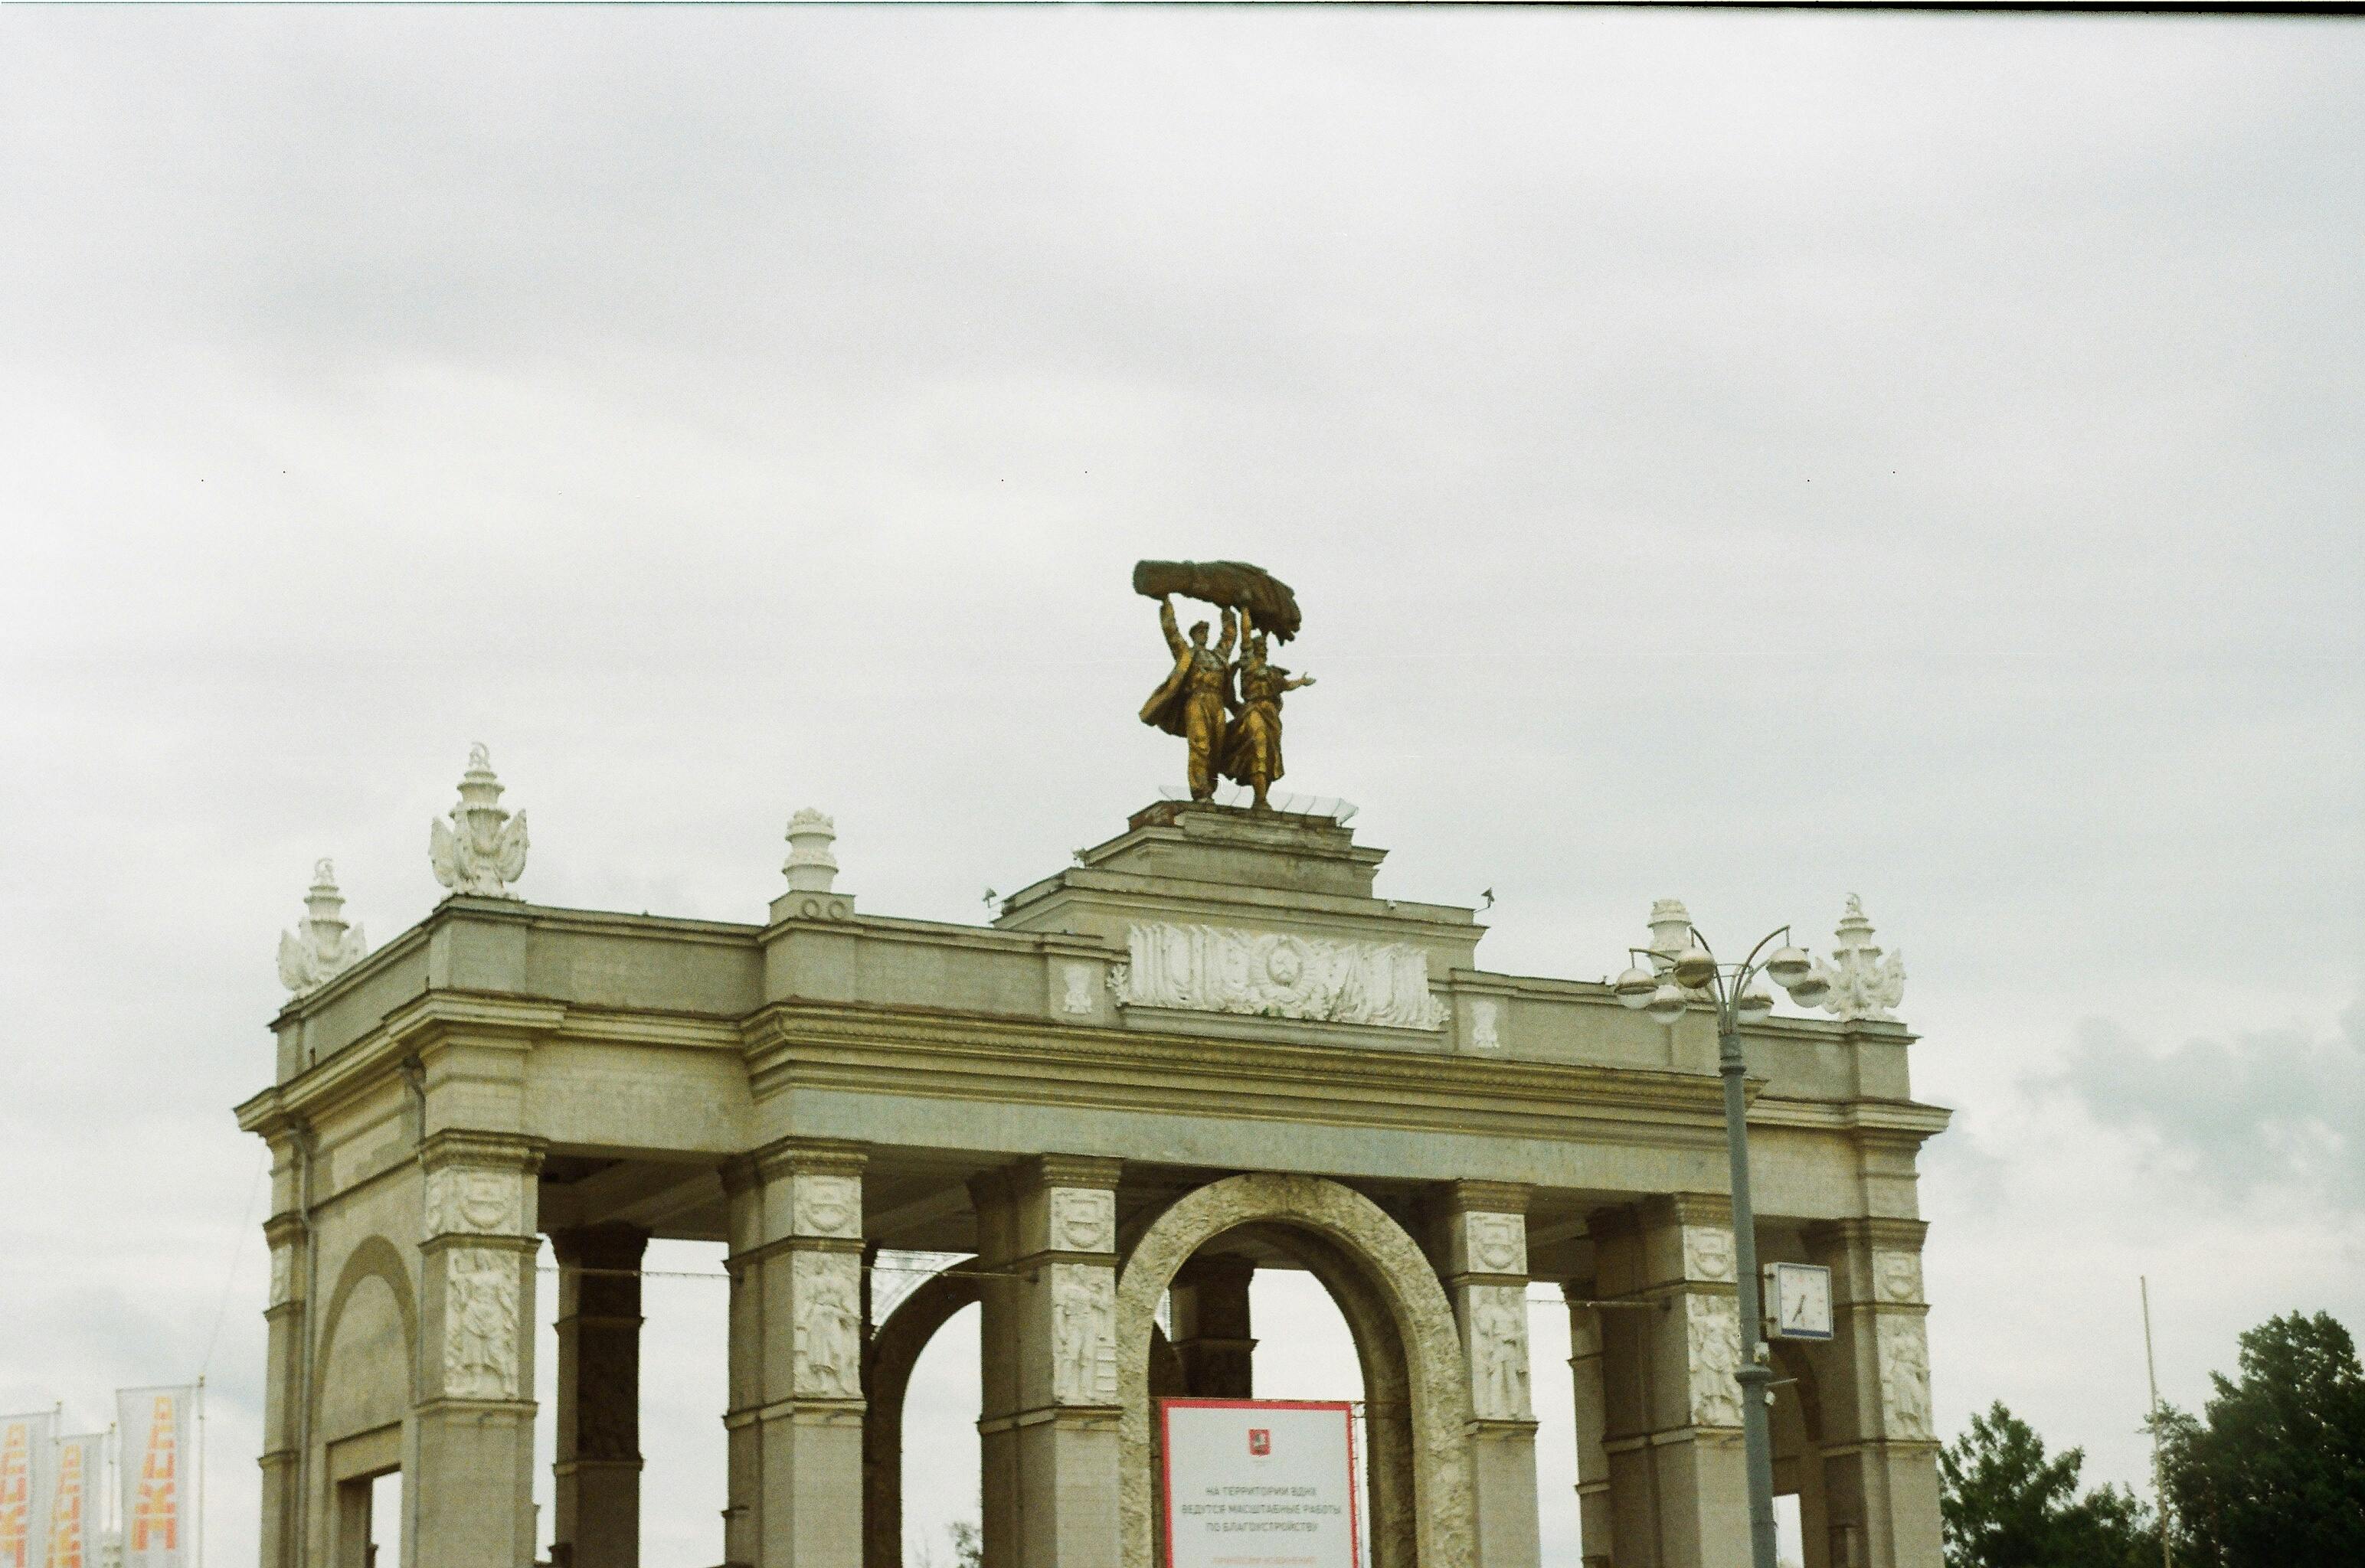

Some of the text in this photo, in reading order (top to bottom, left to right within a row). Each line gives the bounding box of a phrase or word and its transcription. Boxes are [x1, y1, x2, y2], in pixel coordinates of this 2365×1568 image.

[1205, 1486, 1220, 1496] НА
[1222, 1486, 1288, 1497] ТЕРРИТОРИИ
[1181, 1504, 1225, 1515] ВЕДУТСЯ
[1302, 1504, 1342, 1514] РАБОТЫ
